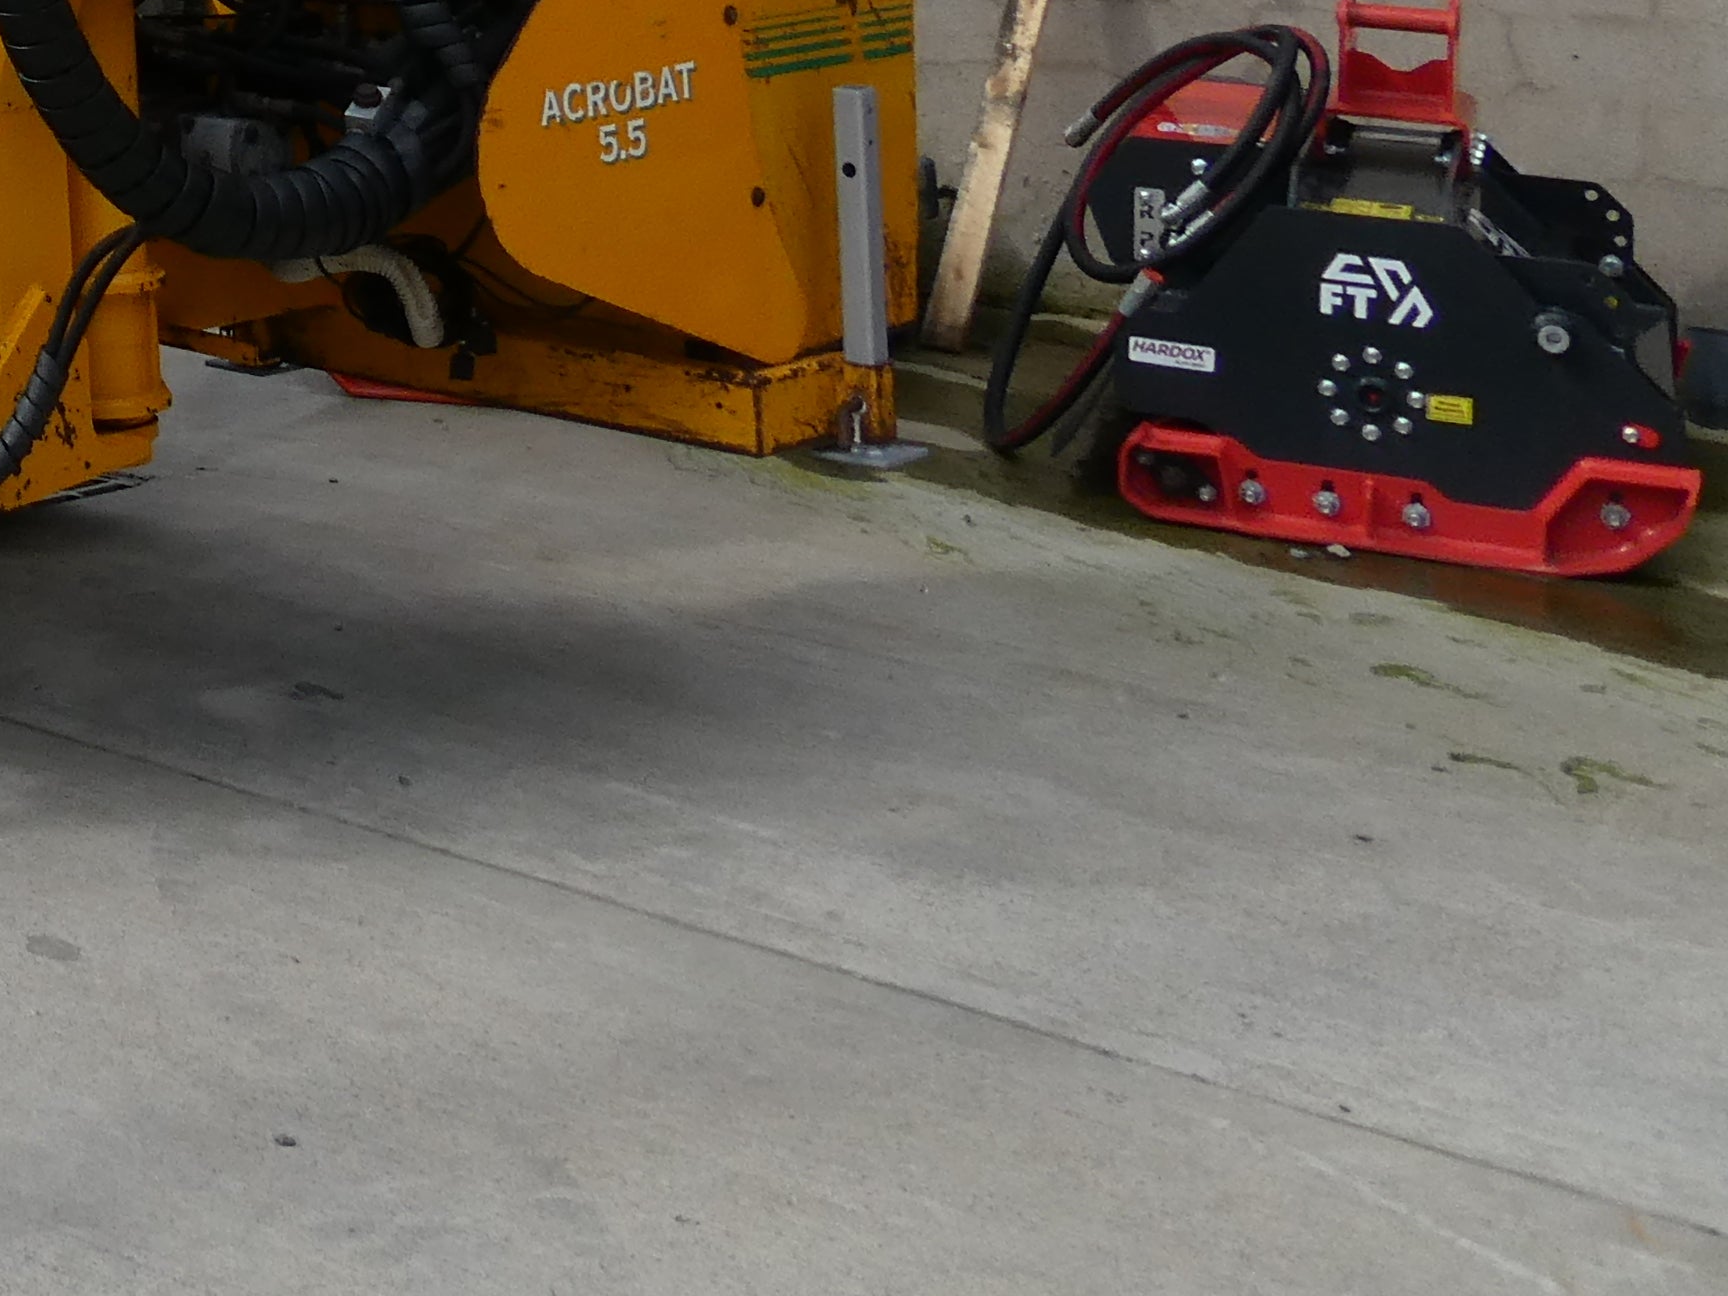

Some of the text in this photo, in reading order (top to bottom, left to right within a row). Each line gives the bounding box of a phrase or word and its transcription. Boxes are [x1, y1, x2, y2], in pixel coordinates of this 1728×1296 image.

[541, 60, 696, 126] ACROBAT
[598, 118, 648, 164] 5.5
[1133, 340, 1205, 362] HARDOX
